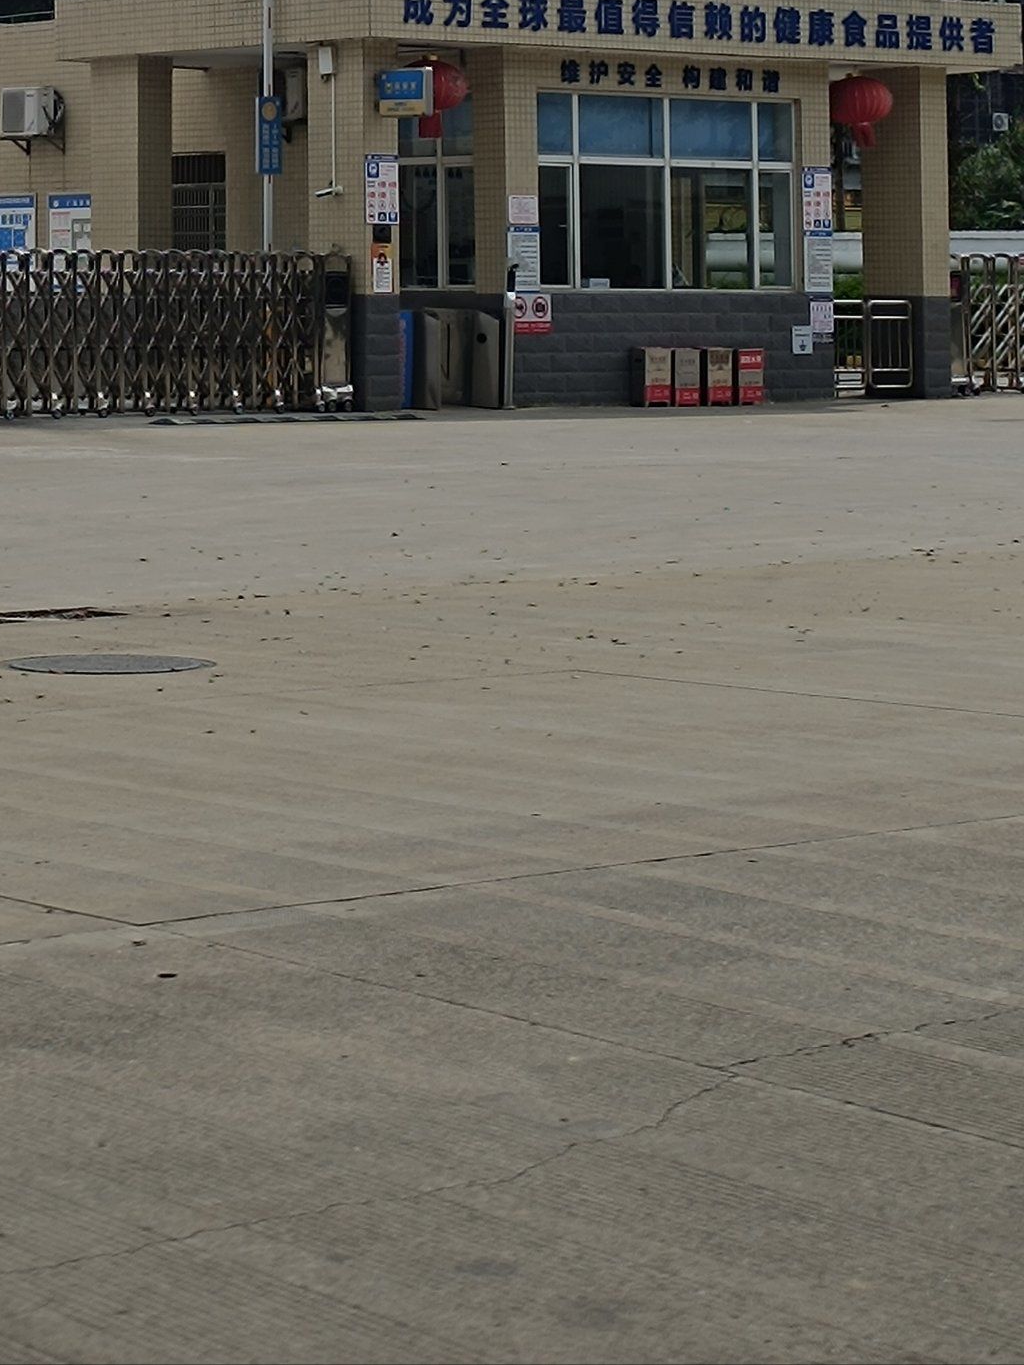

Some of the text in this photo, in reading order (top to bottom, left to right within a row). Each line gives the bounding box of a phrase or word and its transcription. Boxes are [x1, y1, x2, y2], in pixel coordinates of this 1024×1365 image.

[560, 59, 780, 93] 维护安全 构建和谐
